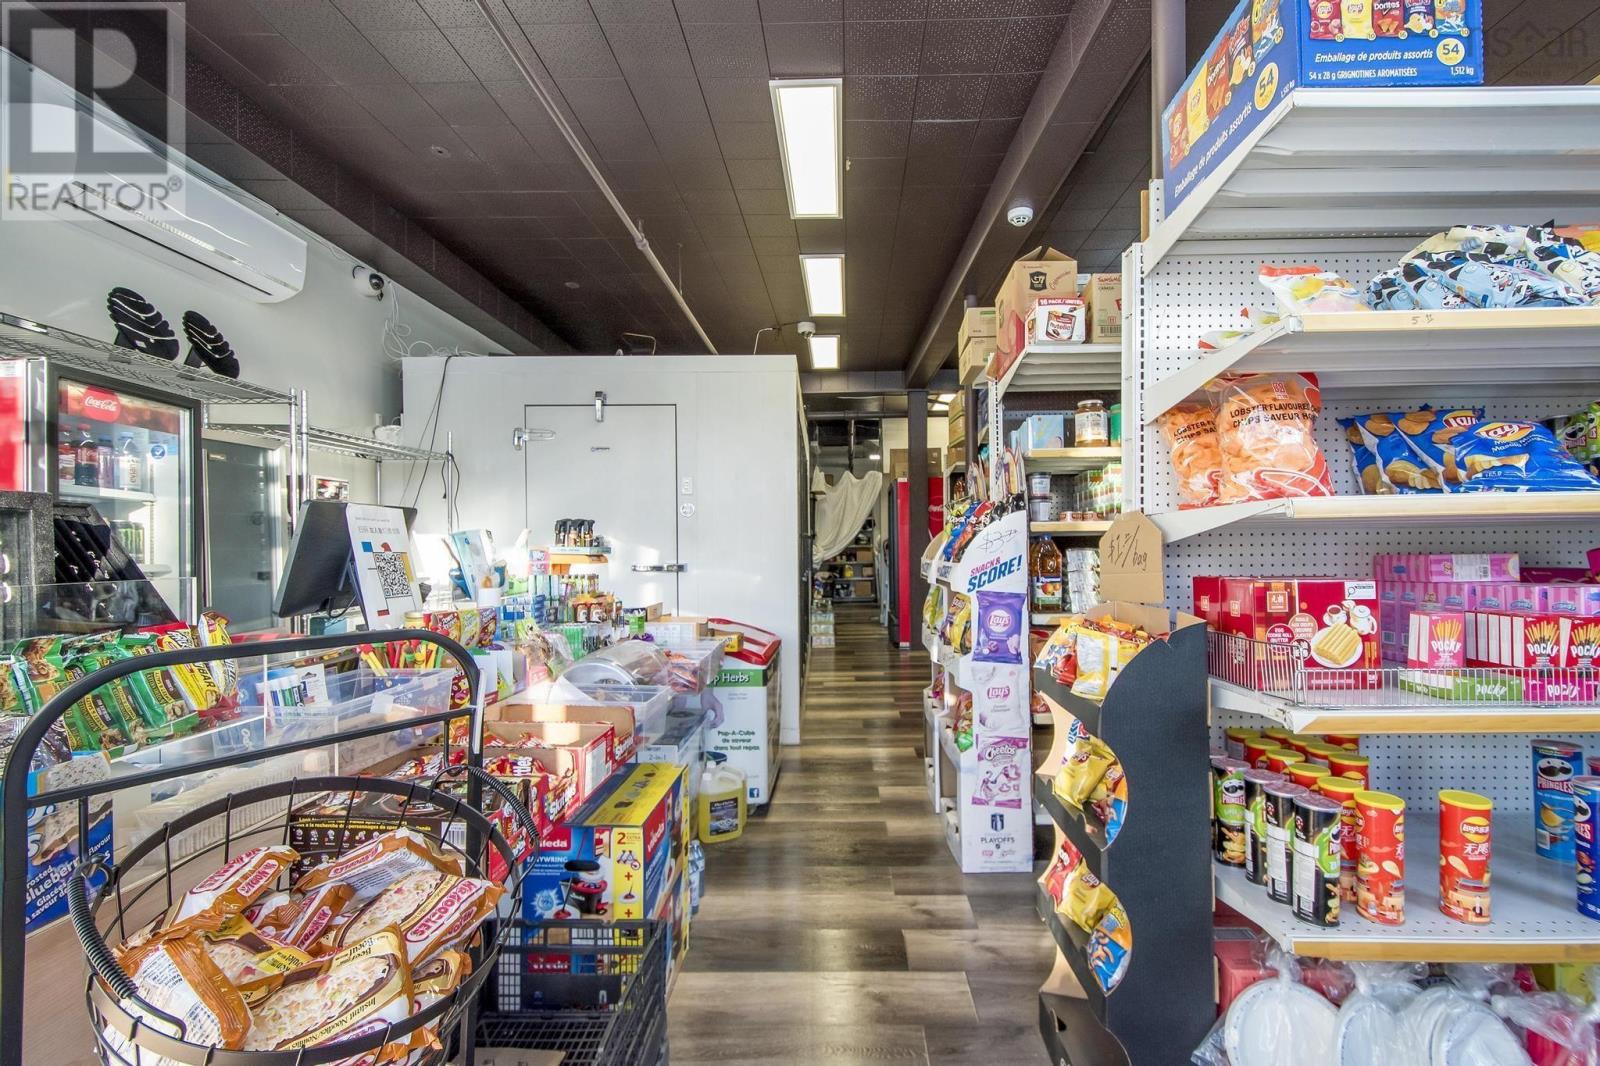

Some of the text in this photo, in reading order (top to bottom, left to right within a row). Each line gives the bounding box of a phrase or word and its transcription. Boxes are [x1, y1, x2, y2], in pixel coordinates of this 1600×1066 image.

[1314, 48, 1433, 63] Emballage de produits assortis
[1442, 44, 1459, 56] 54
[1308, 71, 1317, 80] 54
[1323, 71, 1331, 79] 28
[1331, 72, 1336, 82] g
[1337, 69, 1376, 80] GRIGNOTINES
[1377, 66, 1418, 78] AROMATISÉES
[1466, 66, 1474, 77] kg
[1259, 68, 1274, 97] 54
[1174, 163, 1199, 198] Emballage
[1205, 132, 1229, 165] produits
[1229, 101, 1253, 136] assortis
[84, 395, 117, 412] Coca-Cola
[1230, 402, 1312, 418] LOBSTER FLAVOURED
[1263, 413, 1300, 423] SAVEUR
[129, 457, 139, 484] evian
[966, 554, 1023, 593] SCORE!
[970, 558, 995, 577] SNACK
[1431, 641, 1462, 652] POCKY
[1526, 643, 1560, 657] POCKY
[721, 671, 750, 683] Herbs
[1475, 683, 1507, 696] POCKY
[985, 744, 1016, 761] Cheetos
[1537, 776, 1574, 794] PRINGLES
[88, 834, 112, 857] Flavour
[617, 832, 626, 845] 2
[26, 864, 54, 889] rosted
[31, 896, 58, 918] saveur
[286, 954, 304, 968] oulet
[349, 997, 376, 1020] Instant
